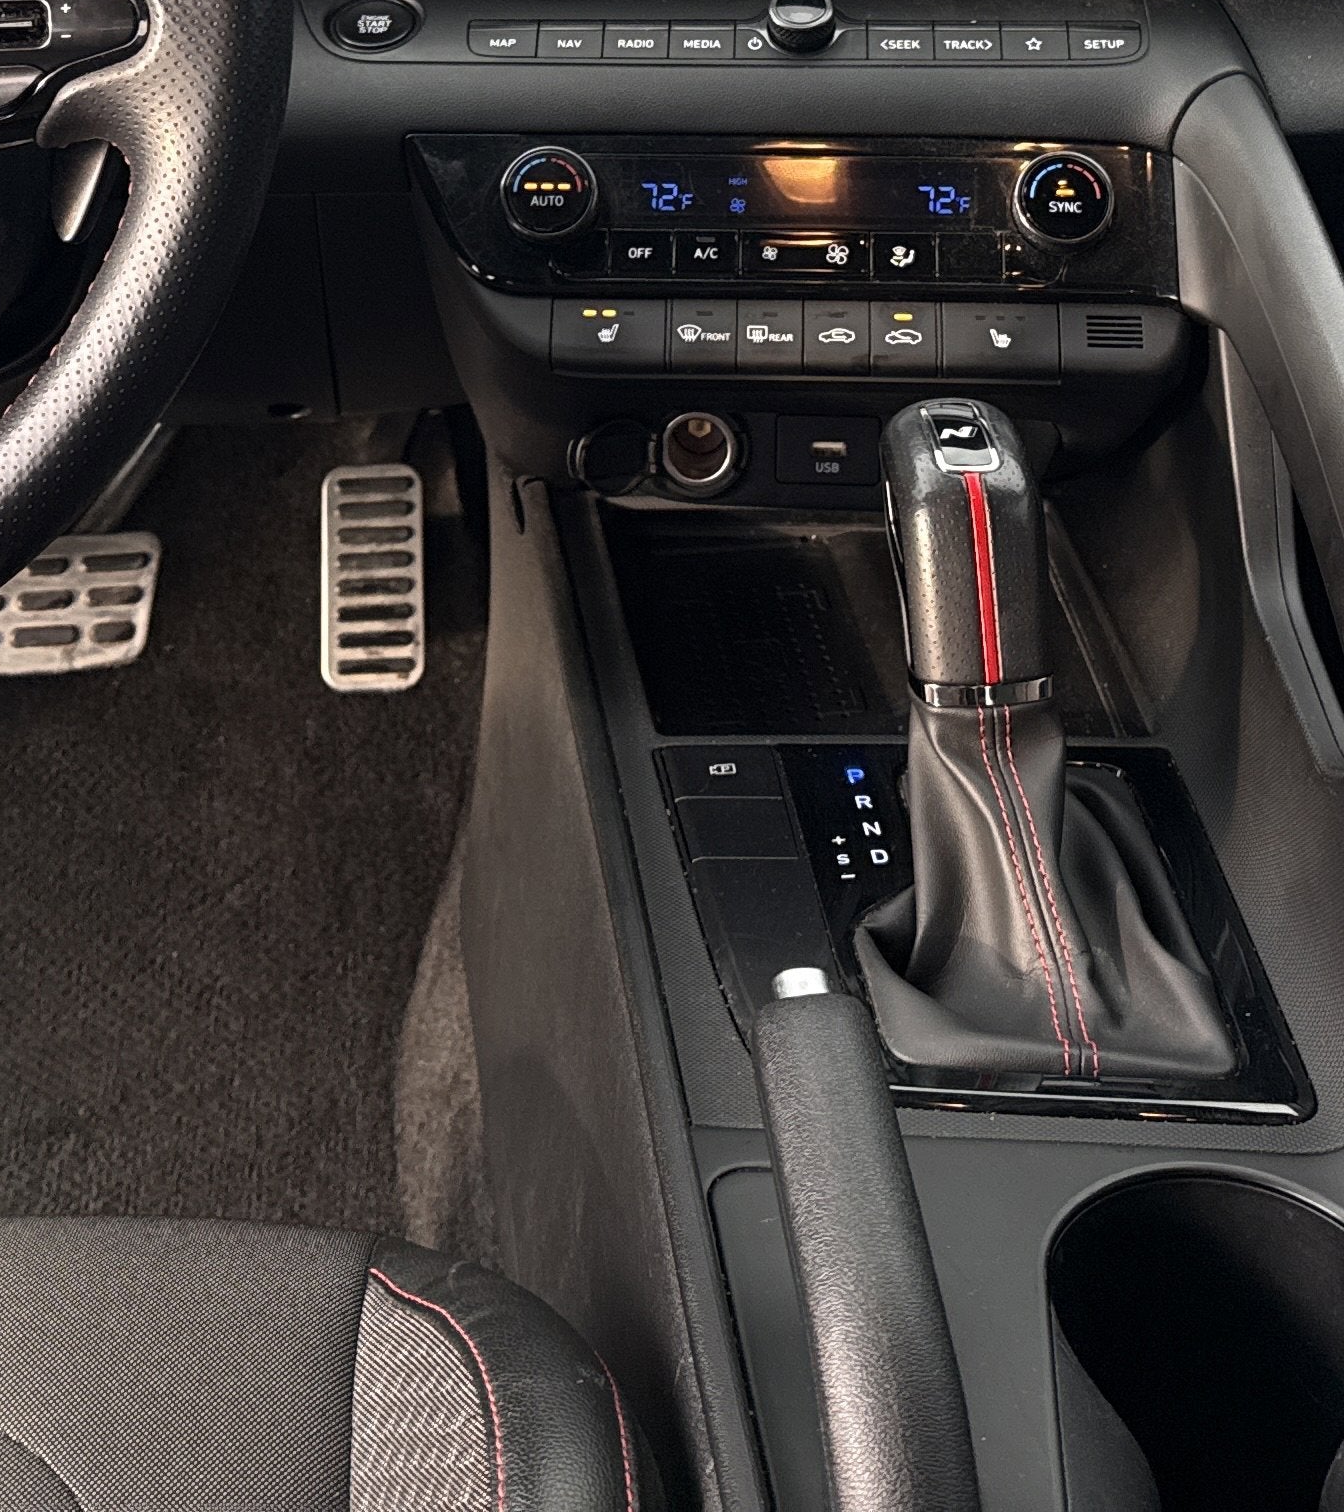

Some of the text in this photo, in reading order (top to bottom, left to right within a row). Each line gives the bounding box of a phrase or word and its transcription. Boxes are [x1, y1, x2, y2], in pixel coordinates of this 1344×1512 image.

[357, 20, 393, 28] START
[358, 26, 389, 34] STOP
[489, 38, 517, 49] MAP
[557, 38, 583, 49] NAV
[617, 38, 654, 50] RADIO
[682, 38, 722, 50] MEDIA
[1084, 39, 1125, 50] SETUP
[530, 194, 564, 208] AUTO
[1048, 200, 1083, 214] SYNC
[628, 248, 652, 260] OFF
[694, 247, 718, 261] A/C
[701, 332, 731, 343] FRONT
[767, 333, 794, 344] REAR
[815, 462, 840, 474] USB
[845, 769, 865, 784] P
[856, 795, 873, 809] R
[863, 822, 882, 836] N
[870, 848, 889, 864] D
